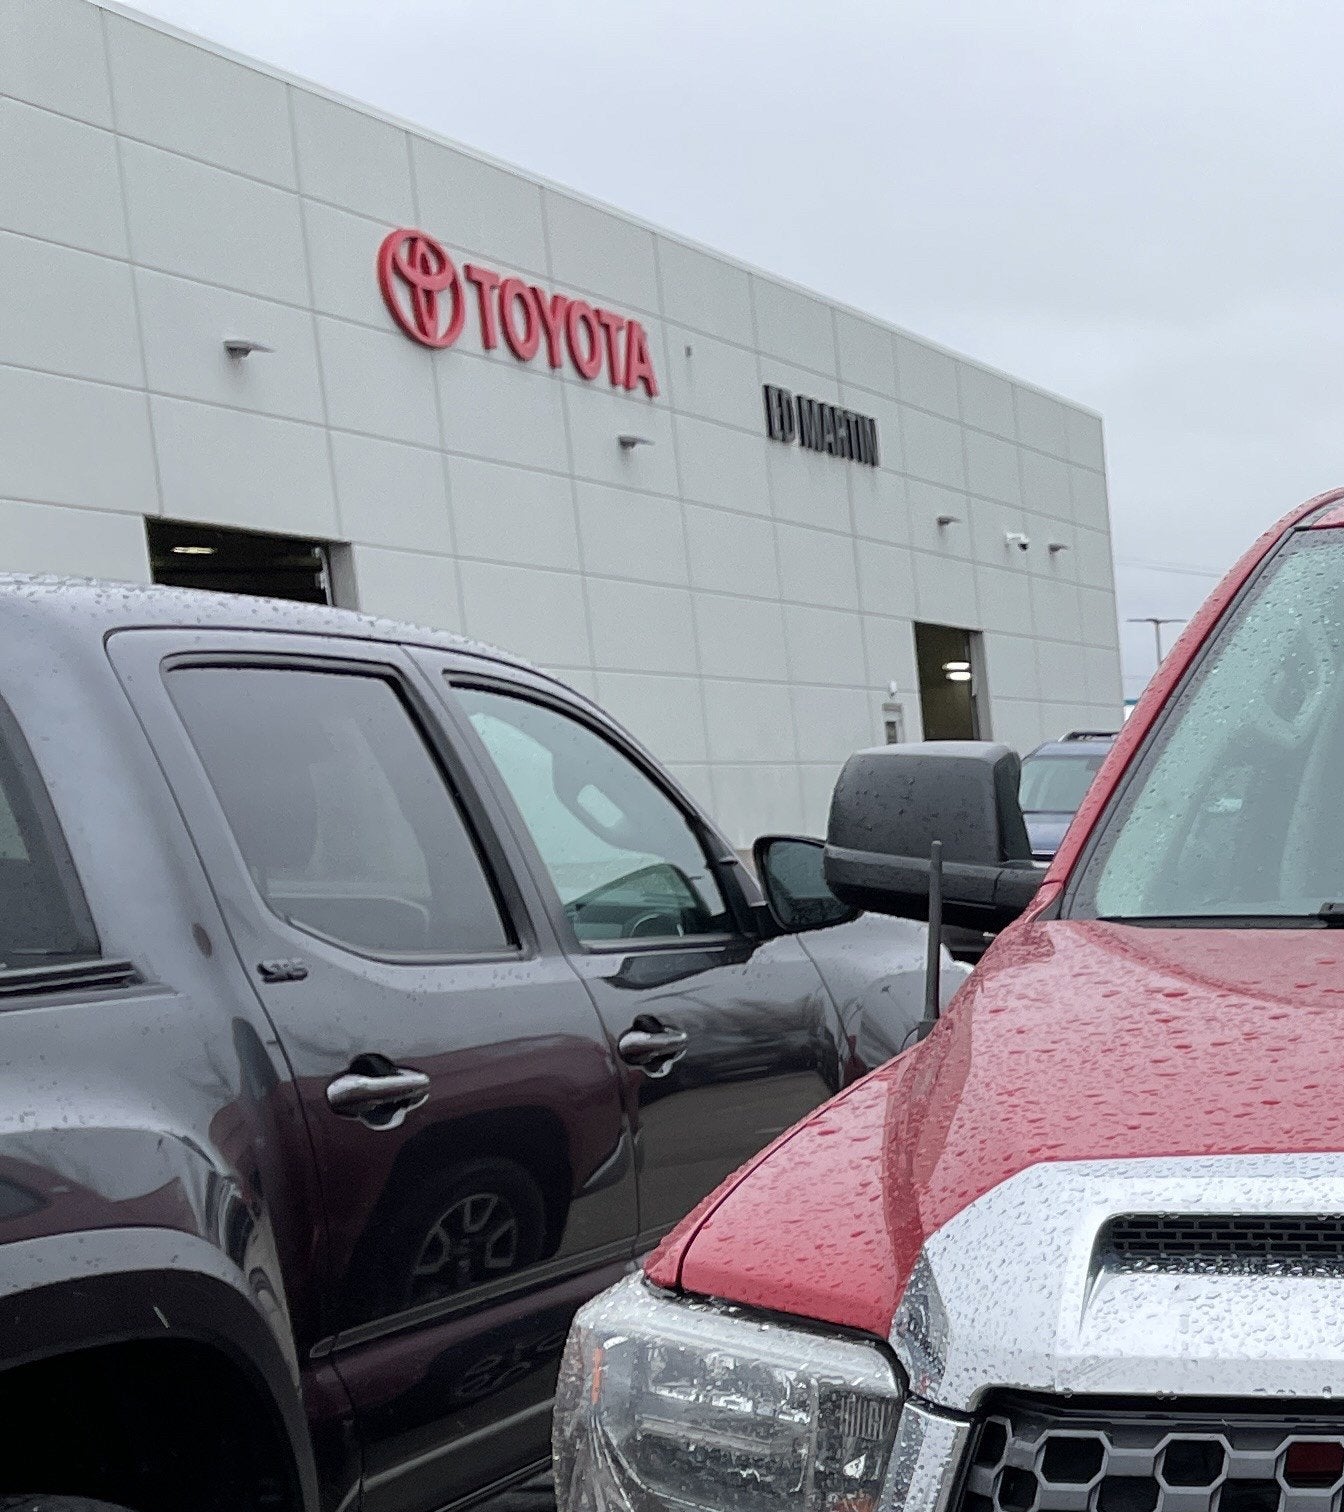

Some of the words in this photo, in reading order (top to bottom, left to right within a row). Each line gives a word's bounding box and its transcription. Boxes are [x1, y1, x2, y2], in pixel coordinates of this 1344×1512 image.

[463, 263, 660, 398] TOYOTA
[763, 384, 795, 443] ED
[796, 394, 880, 467] MARTIN
